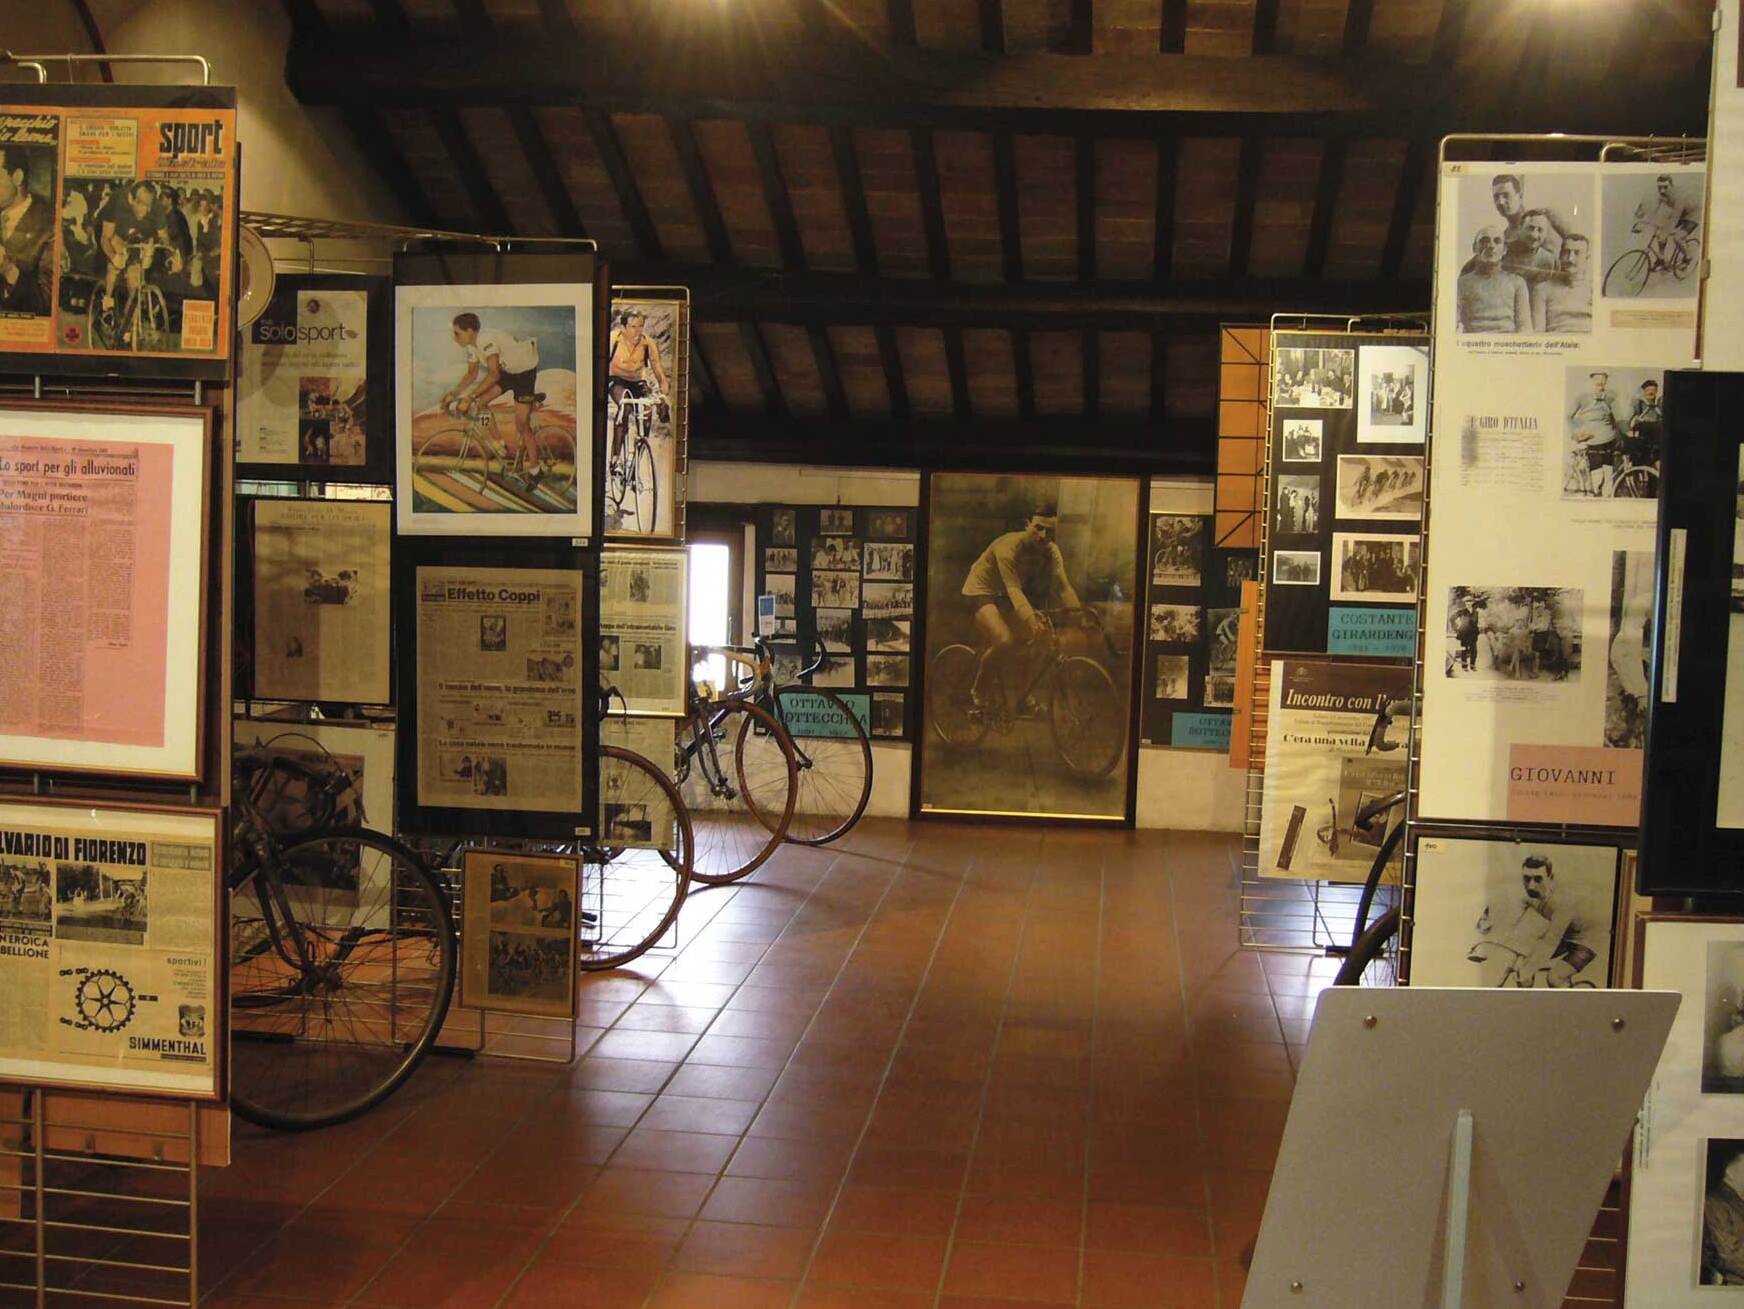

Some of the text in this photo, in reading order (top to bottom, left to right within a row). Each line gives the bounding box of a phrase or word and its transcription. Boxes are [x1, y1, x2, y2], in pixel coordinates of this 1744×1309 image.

[159, 119, 223, 160] sport
[480, 415, 490, 426] 12
[14, 460, 39, 473] sport
[43, 463, 60, 476] per
[64, 459, 77, 476] gli
[81, 459, 135, 476] alluvionati
[17, 489, 47, 502] Magni
[49, 490, 88, 503] portiere
[447, 588, 541, 605] Effetto Coppi
[790, 698, 855, 710] OTTAVO
[1286, 688, 1344, 708] Incontro
[1347, 697, 1372, 710] con
[1314, 736, 1336, 745] una
[1510, 766, 1616, 785] GIOVANNI
[54, 836, 69, 860] DI
[74, 838, 147, 866] FIORENZO
[129, 1037, 207, 1055] SIMMENTHAL
